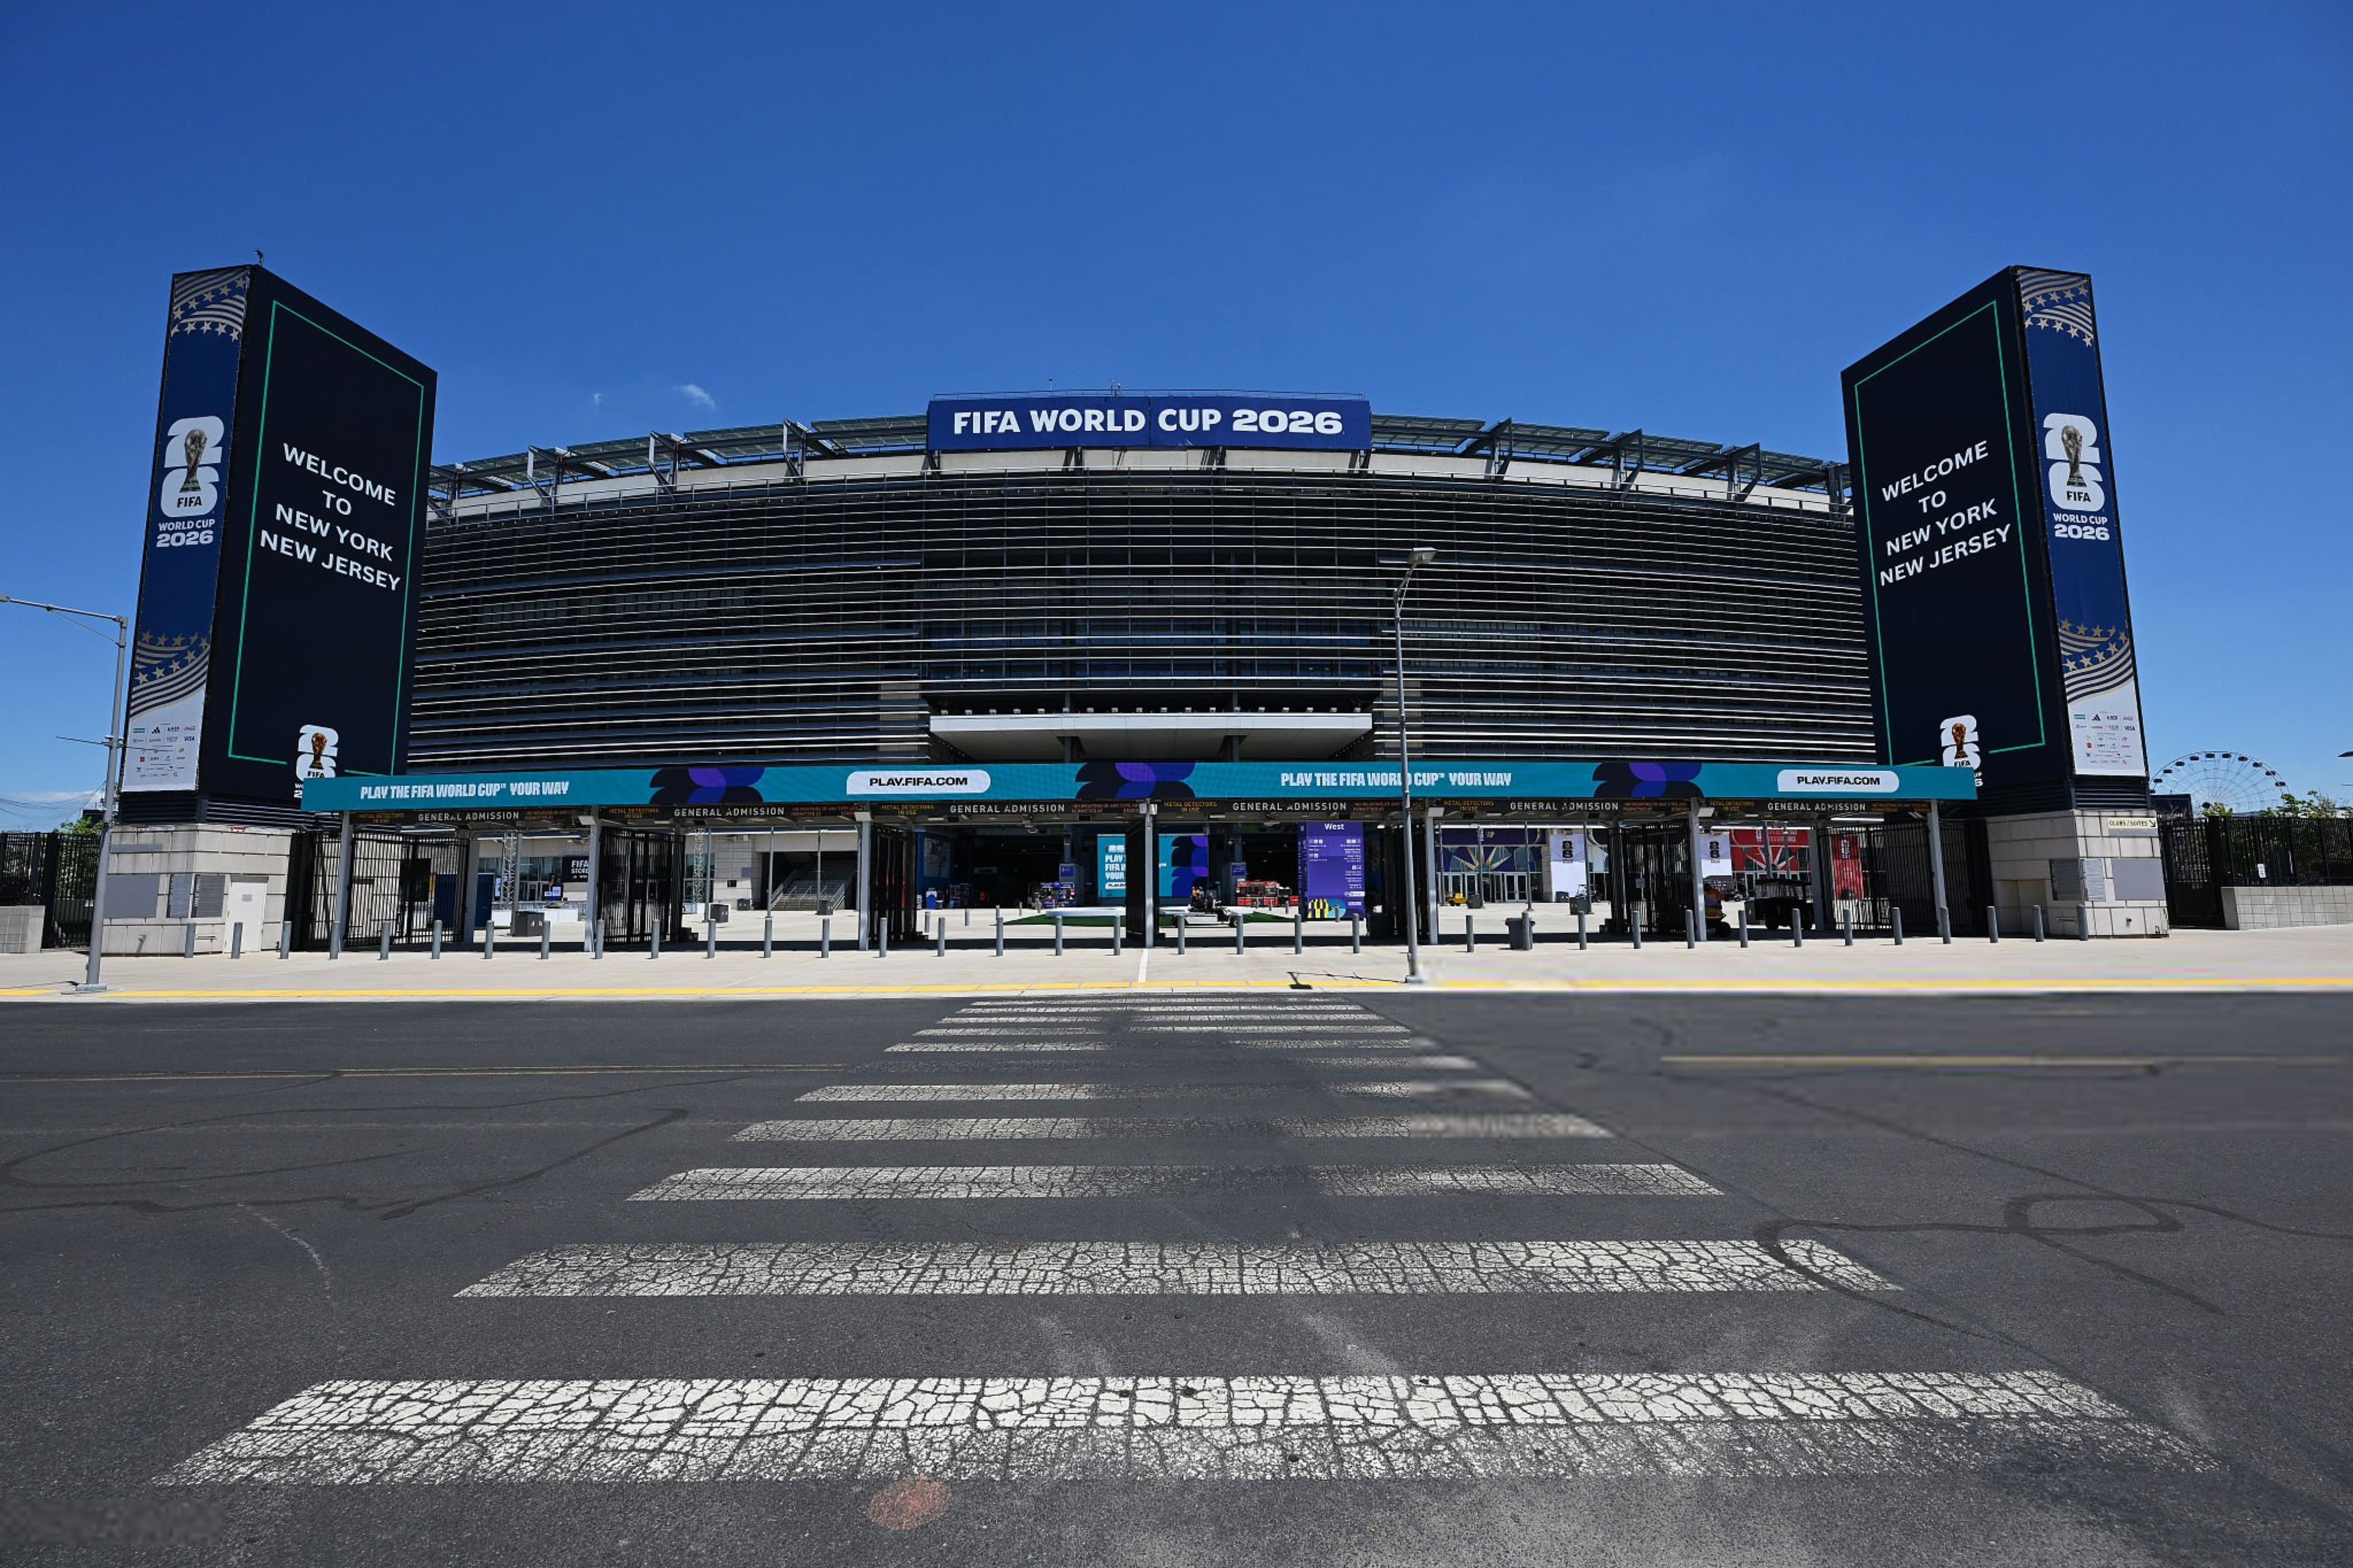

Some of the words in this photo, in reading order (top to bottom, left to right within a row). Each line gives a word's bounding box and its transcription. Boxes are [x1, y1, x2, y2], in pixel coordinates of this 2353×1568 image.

[955, 411, 1020, 434] FIFA
[1030, 409, 1145, 431] WORLD
[1159, 409, 1221, 431] CUP
[1233, 410, 1342, 434] 2026
[284, 443, 395, 508] WELCOME
[1883, 441, 1988, 504] WELCOME
[178, 496, 202, 508] FIFA
[1919, 491, 1946, 512] TO
[2067, 491, 2090, 502] FIFA
[323, 491, 351, 515] TO
[2053, 513, 2088, 523] WORLD
[2089, 516, 2107, 524] CUP
[159, 521, 194, 531] WORLD
[196, 519, 215, 528] CUP
[1887, 525, 1930, 555] NEW
[1934, 496, 1997, 538] YORK
[276, 501, 330, 536] NEW
[337, 526, 392, 563] YORK
[2054, 524, 2109, 540] 2026
[156, 530, 213, 547] 2026
[261, 528, 318, 562] NEW
[322, 551, 400, 590] JERSEY
[1881, 557, 1923, 586] NEW
[1930, 522, 2010, 567] JERSEY
[307, 770, 325, 778] FIFA
[1281, 773, 1312, 786] PLAY
[1314, 773, 1340, 786] THE
[1342, 773, 1365, 786] FIFA
[1449, 773, 1481, 786] YOUR
[1483, 773, 1511, 786] WAY
[870, 778, 967, 786] PLAY.FIFA.COM
[1797, 777, 1880, 785] PLAY.FIFA.COM
[361, 786, 388, 799] PLAY
[391, 786, 410, 798] THE
[411, 785, 434, 797] FIFA
[437, 784, 476, 797] WORLD
[510, 782, 540, 795] YOUR
[542, 782, 569, 794] WAY
[726, 808, 784, 816] ADMISSION
[1004, 804, 1064, 812] ADMISSION
[572, 860, 589, 868] FIFA
[1105, 854, 1123, 863] PLAY
[1105, 863, 1120, 871] FIFA
[1105, 872, 1124, 880] YOUR
